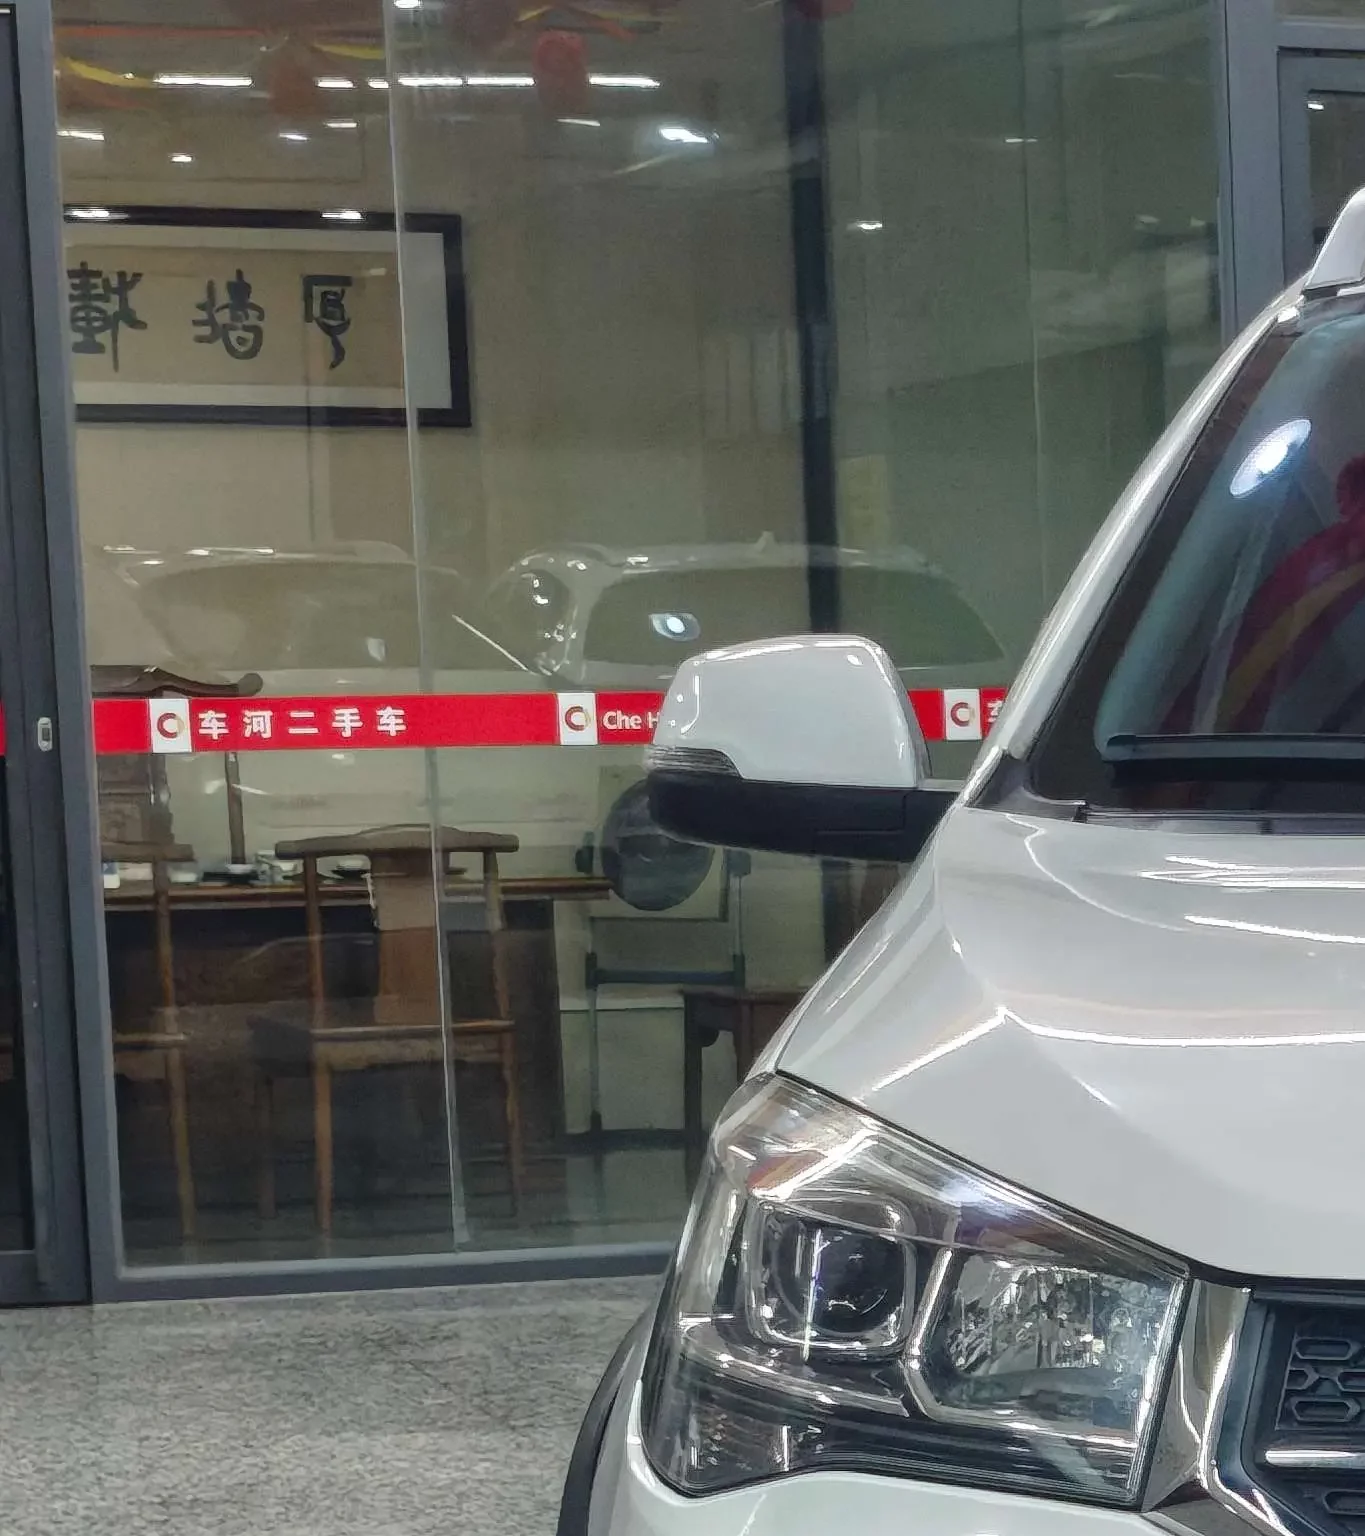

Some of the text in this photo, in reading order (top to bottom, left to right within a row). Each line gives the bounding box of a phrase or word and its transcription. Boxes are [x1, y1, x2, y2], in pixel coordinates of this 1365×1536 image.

[198, 706, 407, 740] 车河二手车
[602, 710, 642, 730] Che
